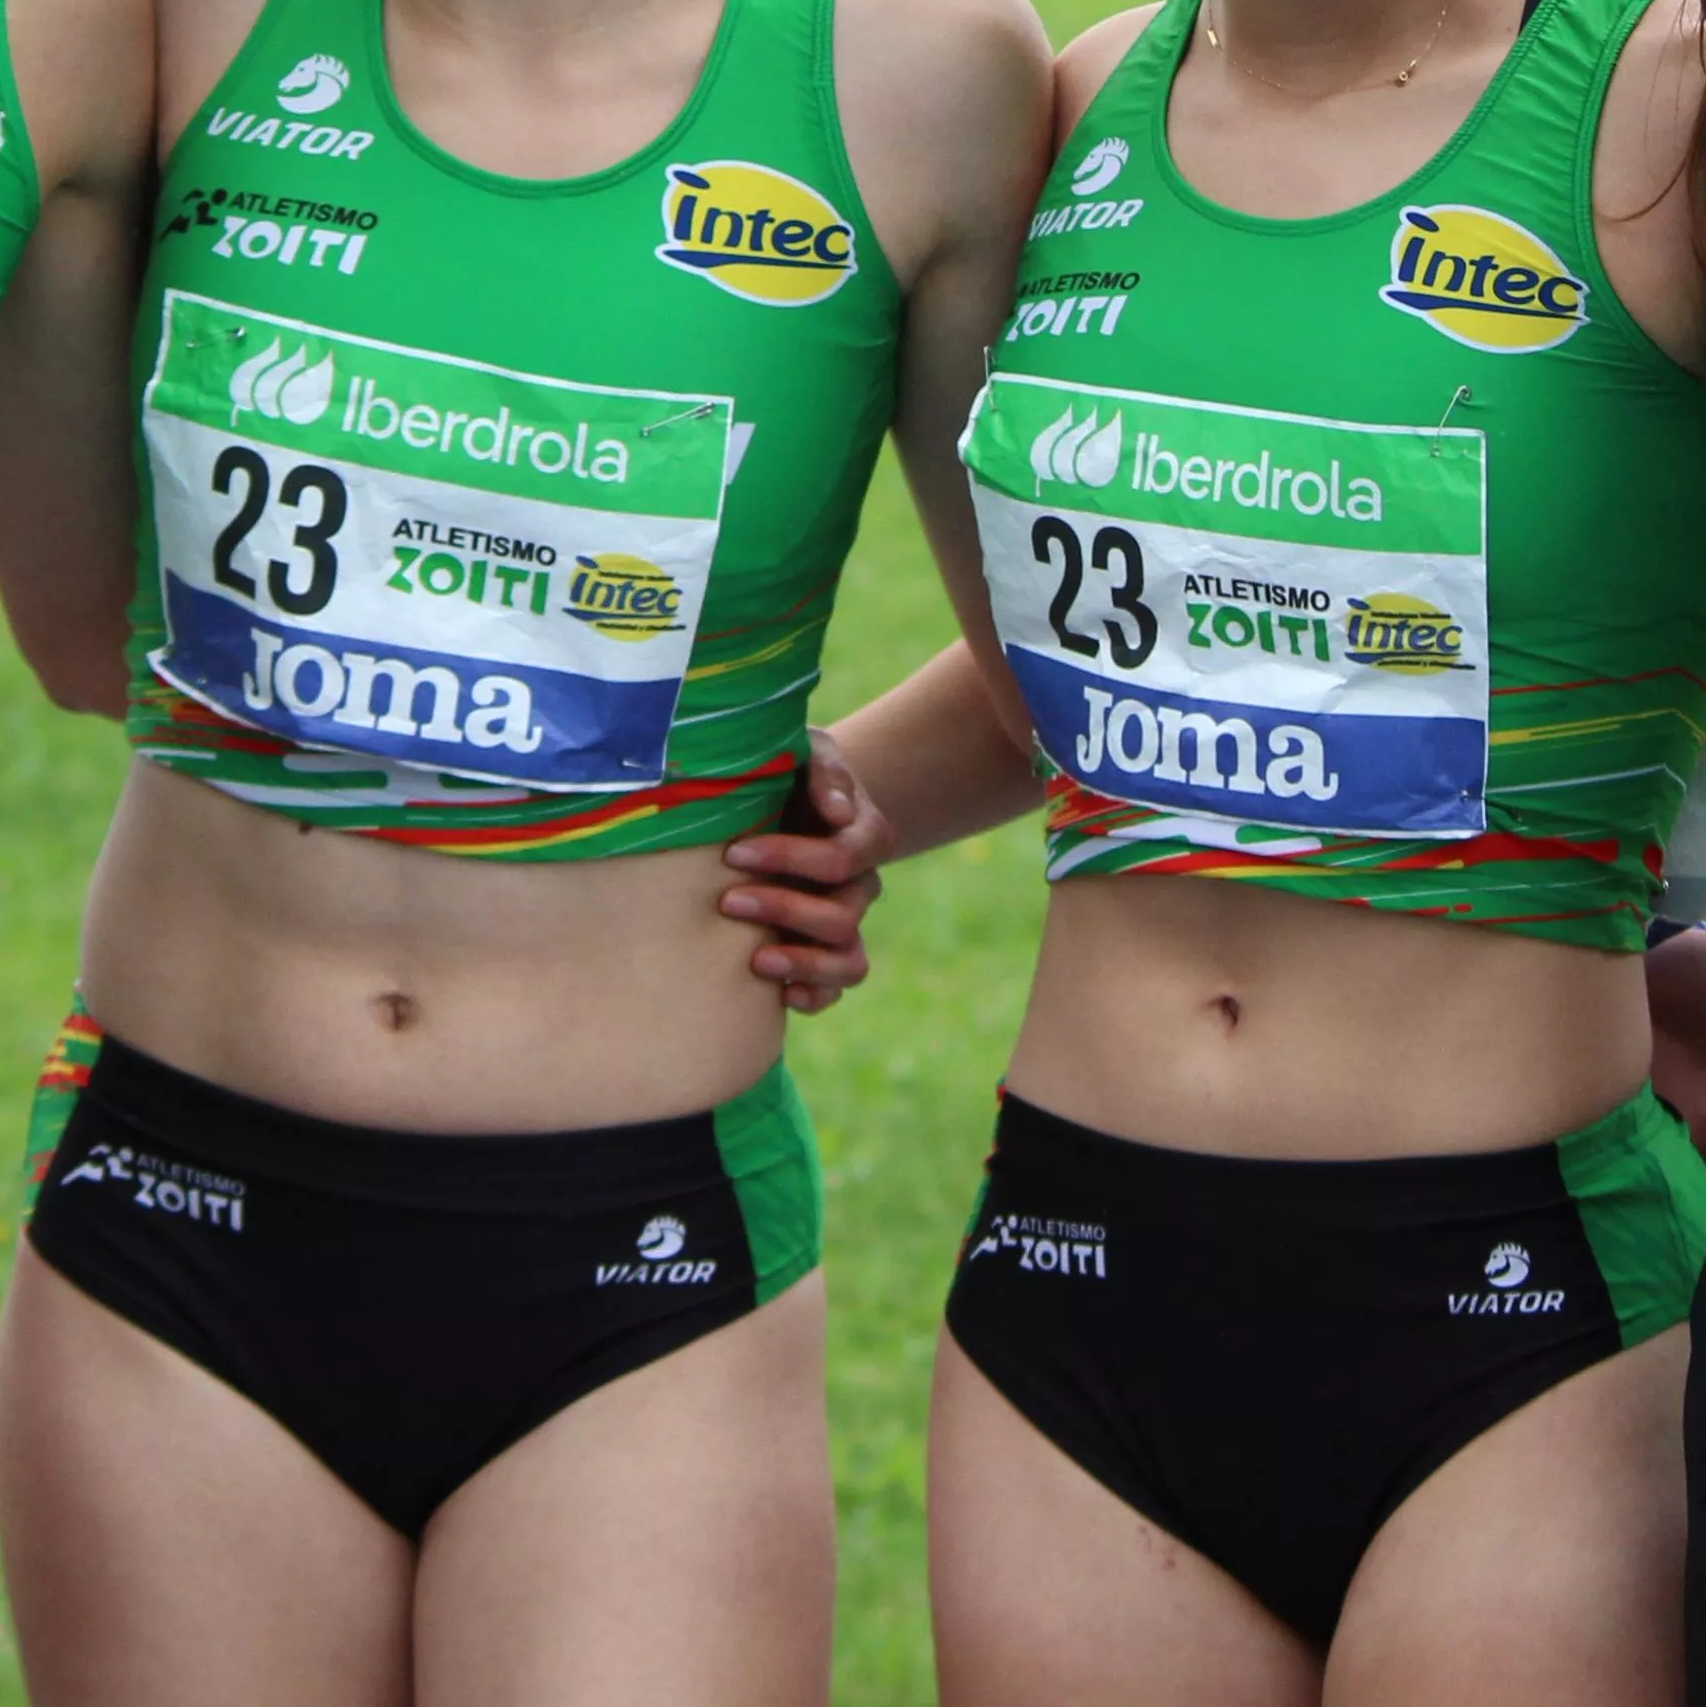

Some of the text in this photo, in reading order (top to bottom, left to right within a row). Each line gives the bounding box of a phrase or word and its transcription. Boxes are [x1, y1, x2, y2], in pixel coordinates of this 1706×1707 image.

[206, 107, 375, 160] VIATOR
[228, 192, 379, 230] ATLETISMO
[672, 169, 853, 264] intec
[1028, 198, 1145, 242] VIATOR
[211, 216, 368, 275] ZOITI
[1397, 211, 1587, 314] intec
[1005, 294, 1129, 342] ZOITI
[341, 375, 629, 483] Iberdrola
[1132, 432, 1383, 522] Iberdrola
[211, 445, 348, 616] 23
[392, 517, 557, 567] ATLETISMO
[388, 547, 550, 615] ZOITI
[569, 554, 684, 614] intec
[1031, 515, 1158, 670] 23
[1183, 574, 1331, 612] ATLETISMO
[1185, 603, 1331, 662] ZOITI
[1346, 597, 1463, 653] intec
[134, 1171, 244, 1232] ZOITI
[136, 1153, 246, 1196] ATLETISMO
[1020, 1217, 1107, 1241] ATLETISMO
[594, 1259, 717, 1286] VIATOR
[1020, 1238, 1108, 1278] ZOITI
[1447, 1289, 1565, 1315] VIATOR
